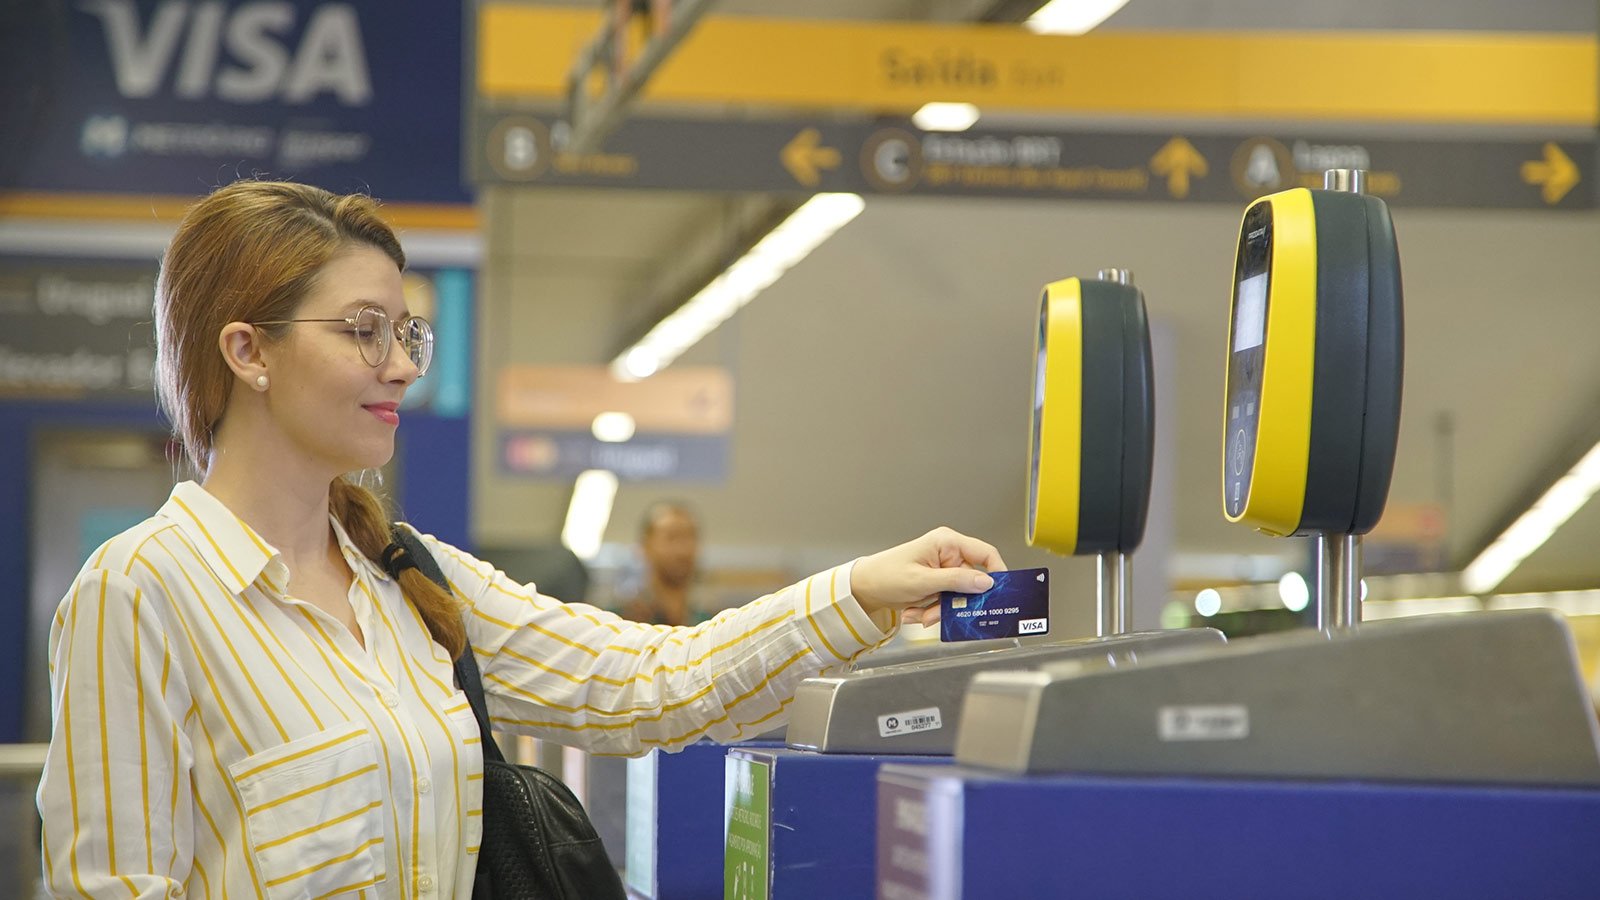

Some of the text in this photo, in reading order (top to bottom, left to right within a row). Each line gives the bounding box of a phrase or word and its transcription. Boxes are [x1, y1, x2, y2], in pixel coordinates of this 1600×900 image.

[76, 0, 373, 106] VISA
[875, 139, 909, 182] C
[1245, 144, 1280, 186] A
[989, 608, 1003, 616] 1000
[1022, 621, 1043, 630] VISA
